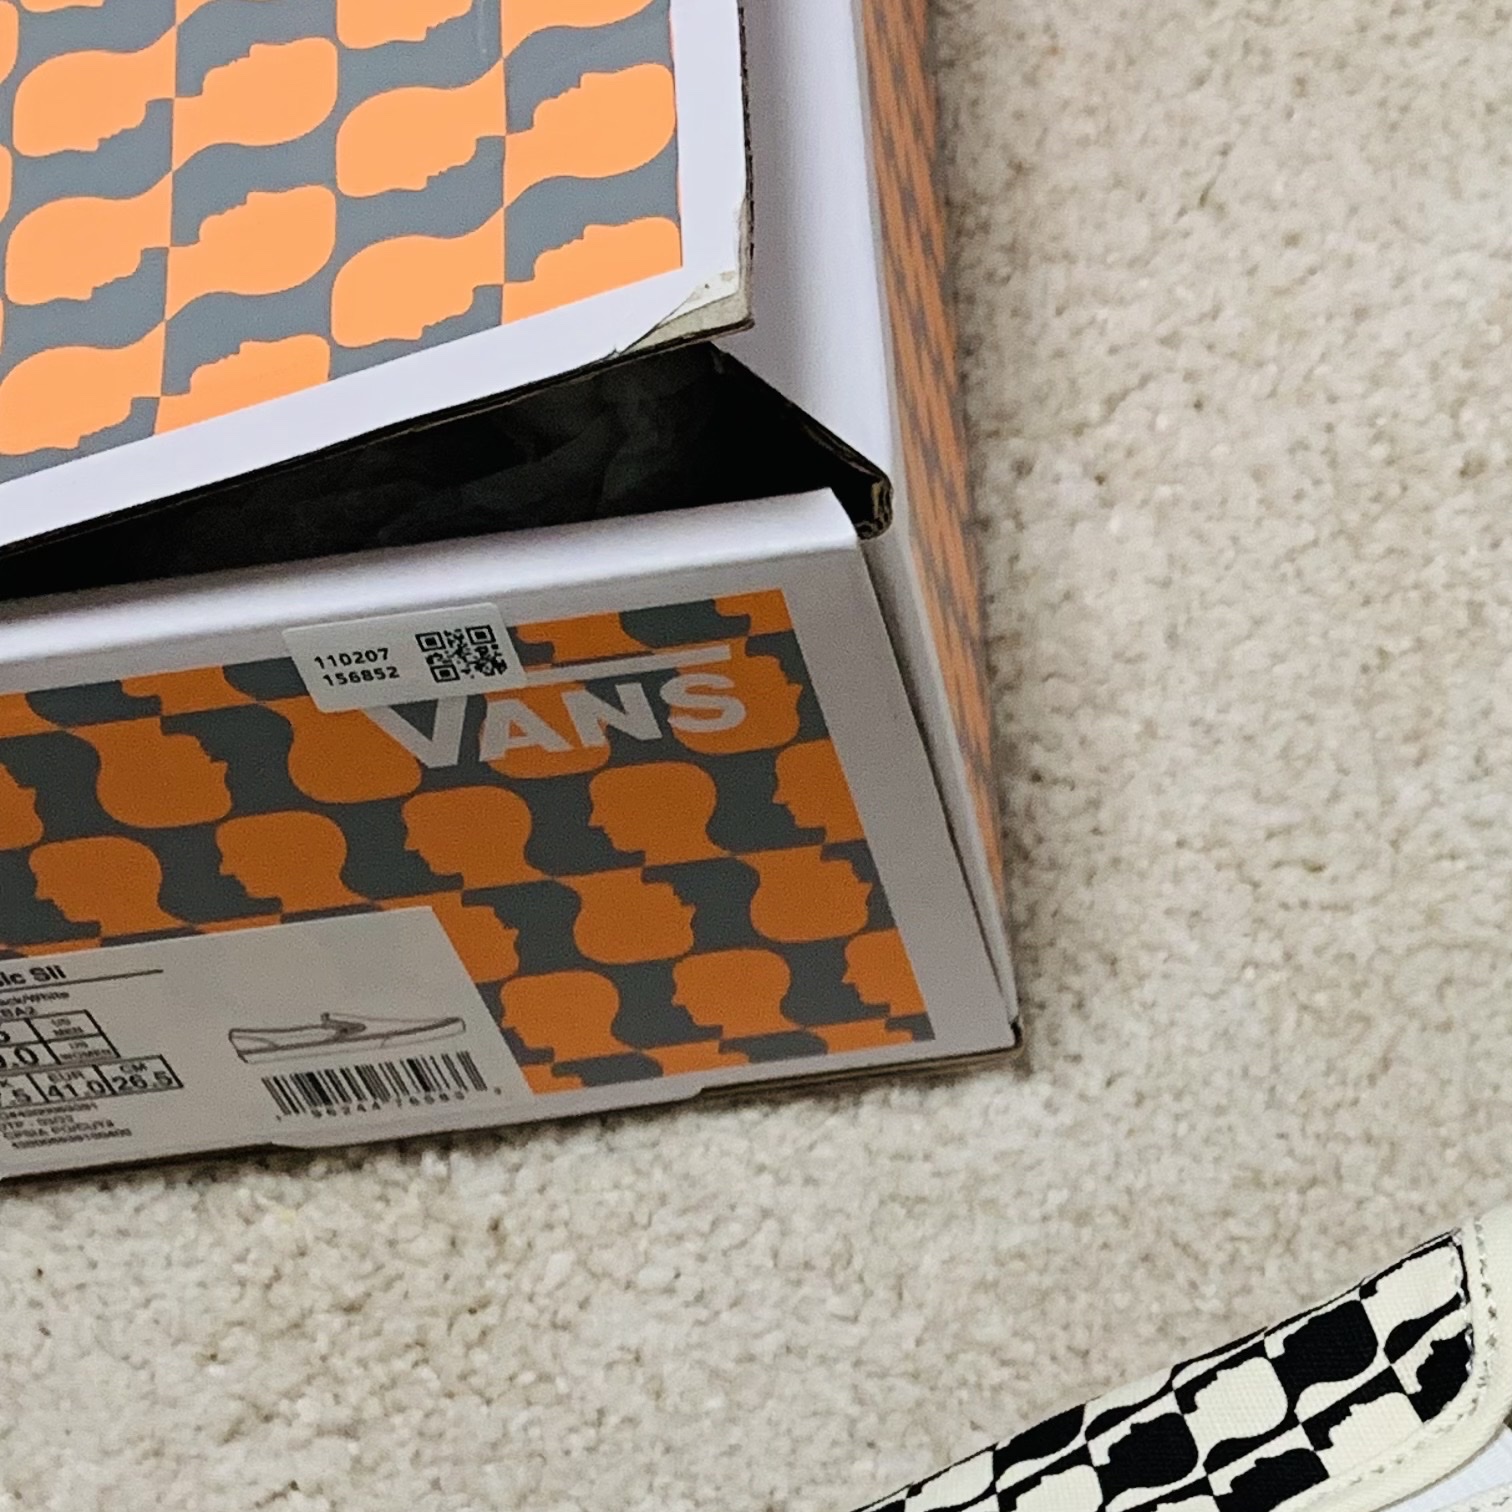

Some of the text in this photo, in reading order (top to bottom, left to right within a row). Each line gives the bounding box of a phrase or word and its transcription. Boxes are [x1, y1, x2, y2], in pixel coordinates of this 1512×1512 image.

[314, 648, 388, 669] 110207
[323, 666, 399, 686] 156852
[361, 645, 746, 769] VANS
[112, 1070, 173, 1091] 26.5
